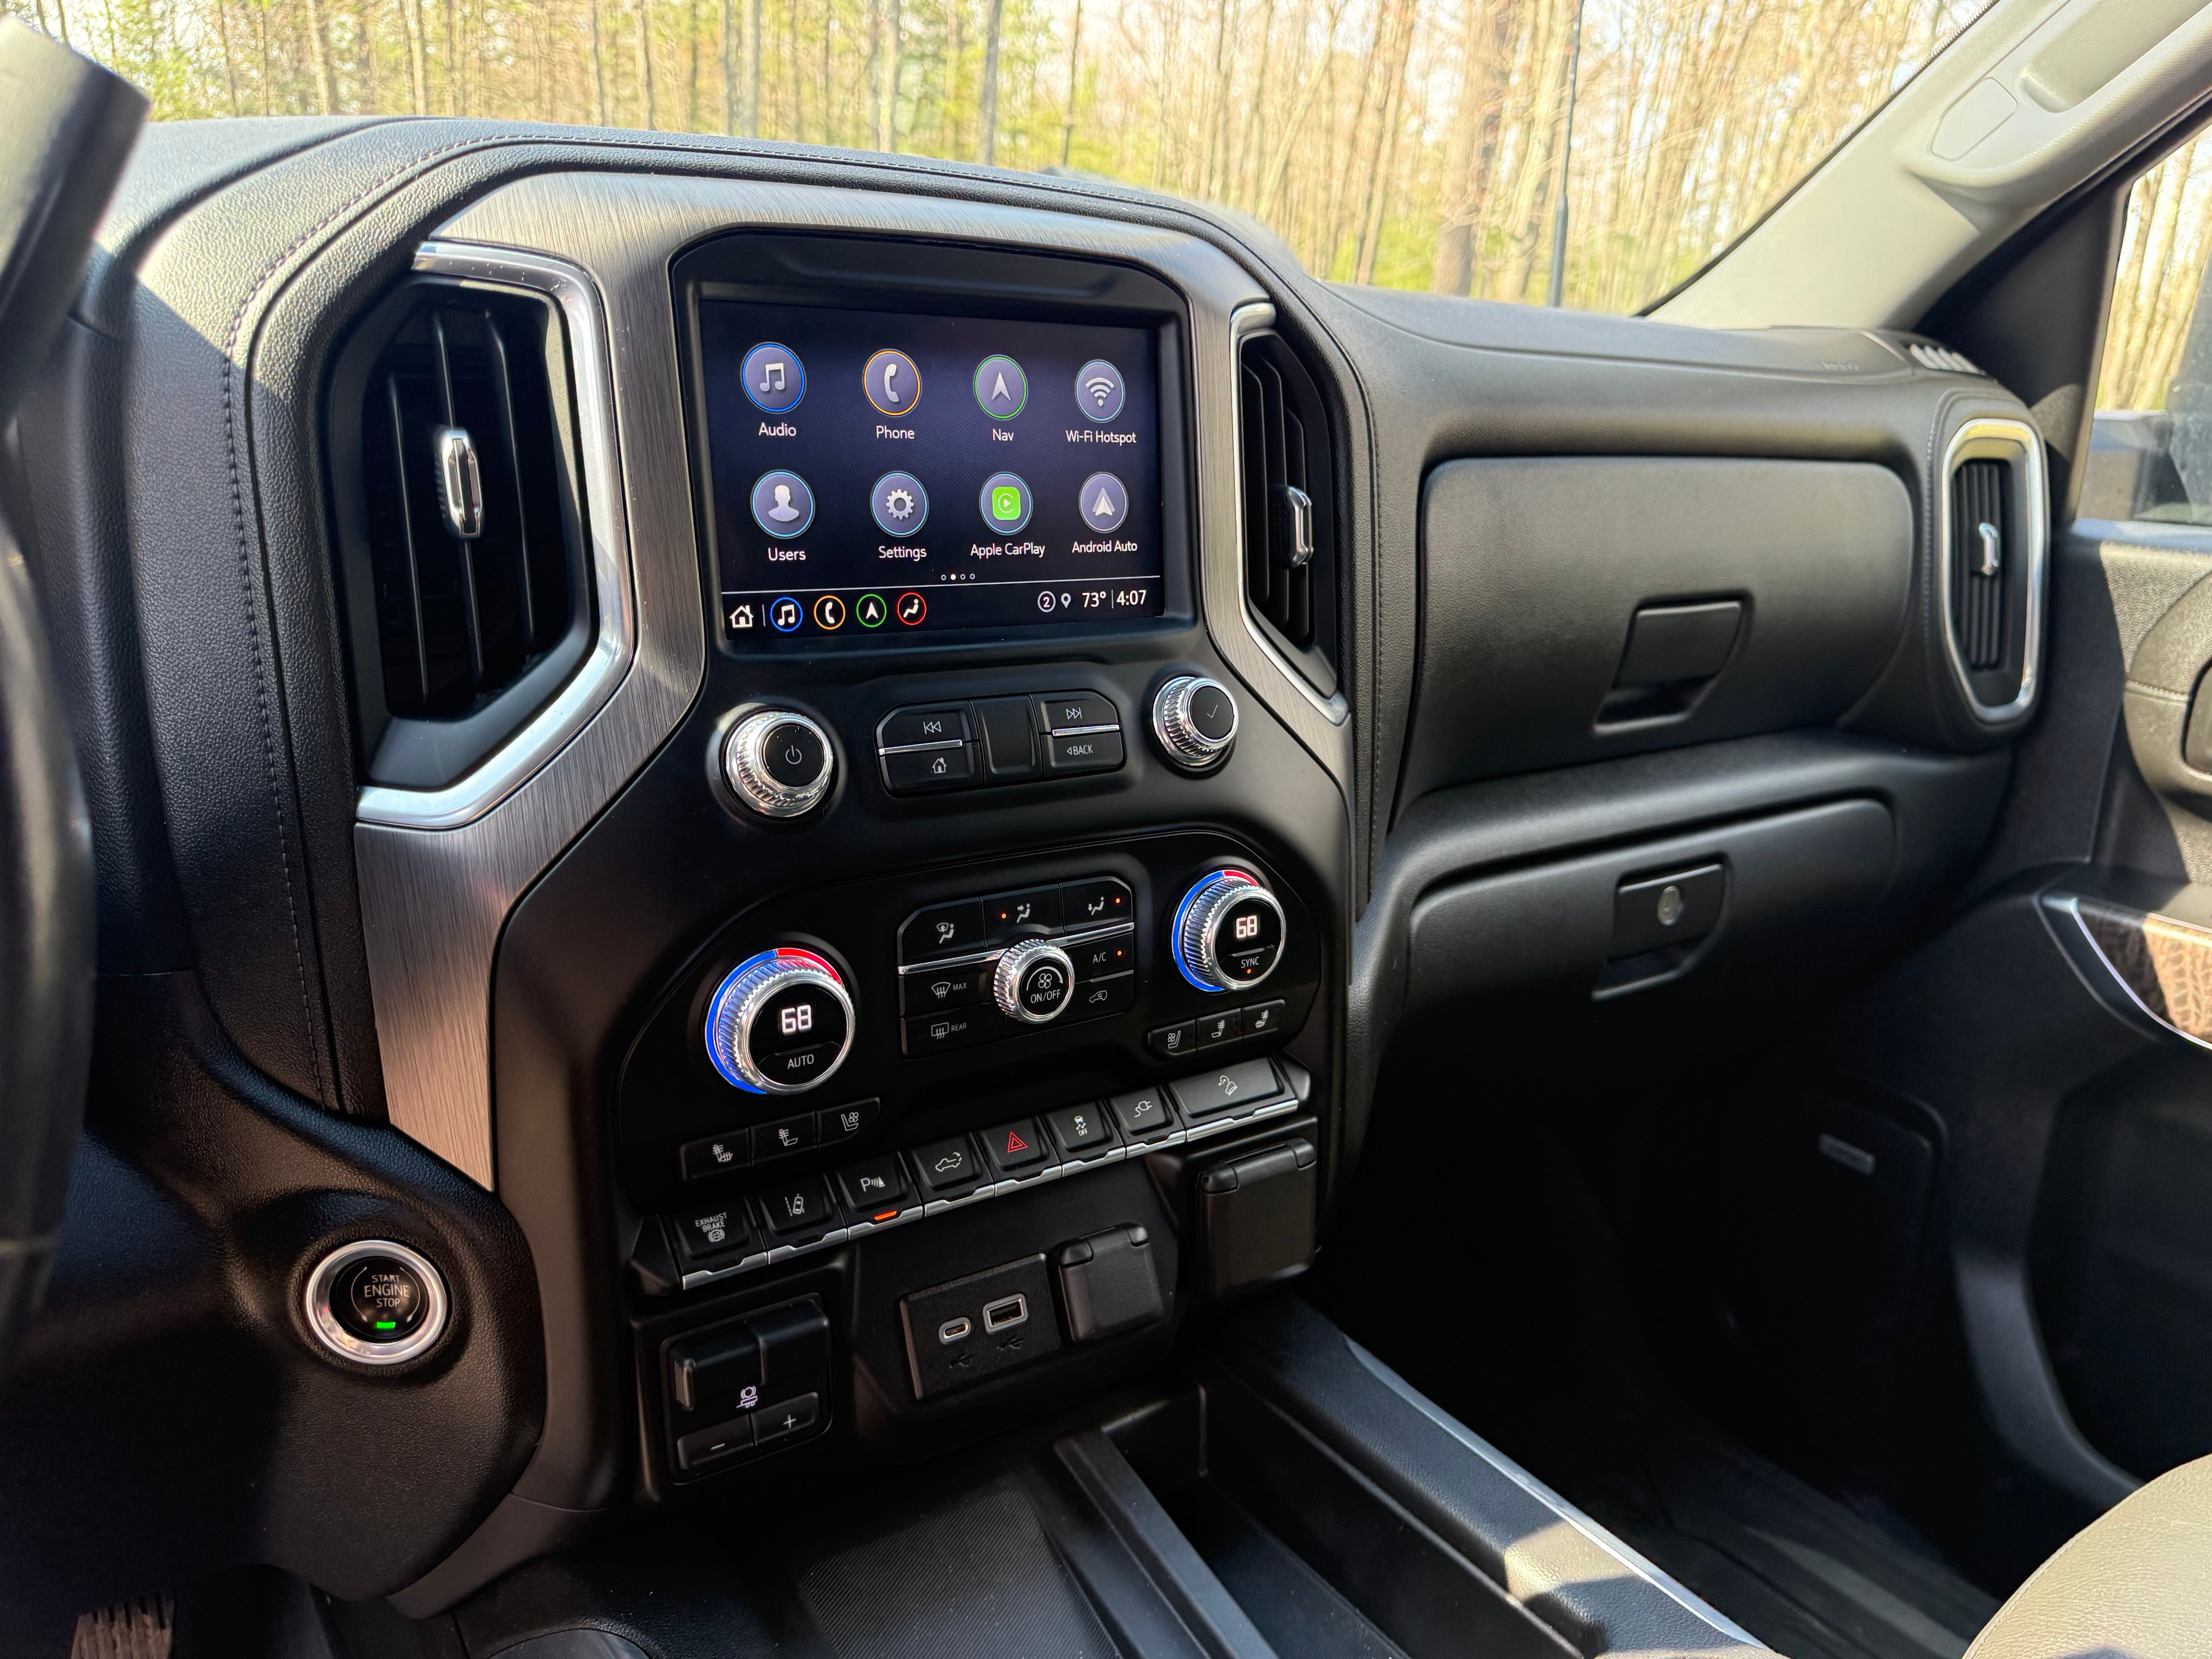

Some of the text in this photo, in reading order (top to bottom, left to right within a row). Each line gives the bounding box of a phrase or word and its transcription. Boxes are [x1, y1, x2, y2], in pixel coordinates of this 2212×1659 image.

[759, 422, 797, 436] Audio
[876, 425, 915, 439] Phone
[993, 428, 1014, 441] Nav
[1065, 430, 1137, 446] Wi-Fi Hotspot
[970, 542, 1045, 559] Apple CarPlay
[1072, 540, 1137, 553] Android Auto
[768, 548, 806, 561] Users
[879, 546, 927, 562] Settings
[1042, 596, 1051, 608] 2
[1116, 590, 1146, 606] 4:07
[1073, 744, 1093, 755] BACK
[1236, 915, 1257, 939] 68
[1092, 952, 1106, 963] A/C
[1240, 957, 1260, 969] SYNC
[953, 982, 967, 991] MAX
[1029, 988, 1062, 1004] ON/OFF
[781, 1005, 812, 1034] 68
[951, 1023, 967, 1032] REAR
[787, 1054, 814, 1069] AUTO
[695, 1212, 727, 1227] EXHAUST
[702, 1220, 725, 1232] BRAKE
[372, 1274, 400, 1283] START
[364, 1284, 410, 1297] ENGINE
[376, 1298, 400, 1307] STOP
